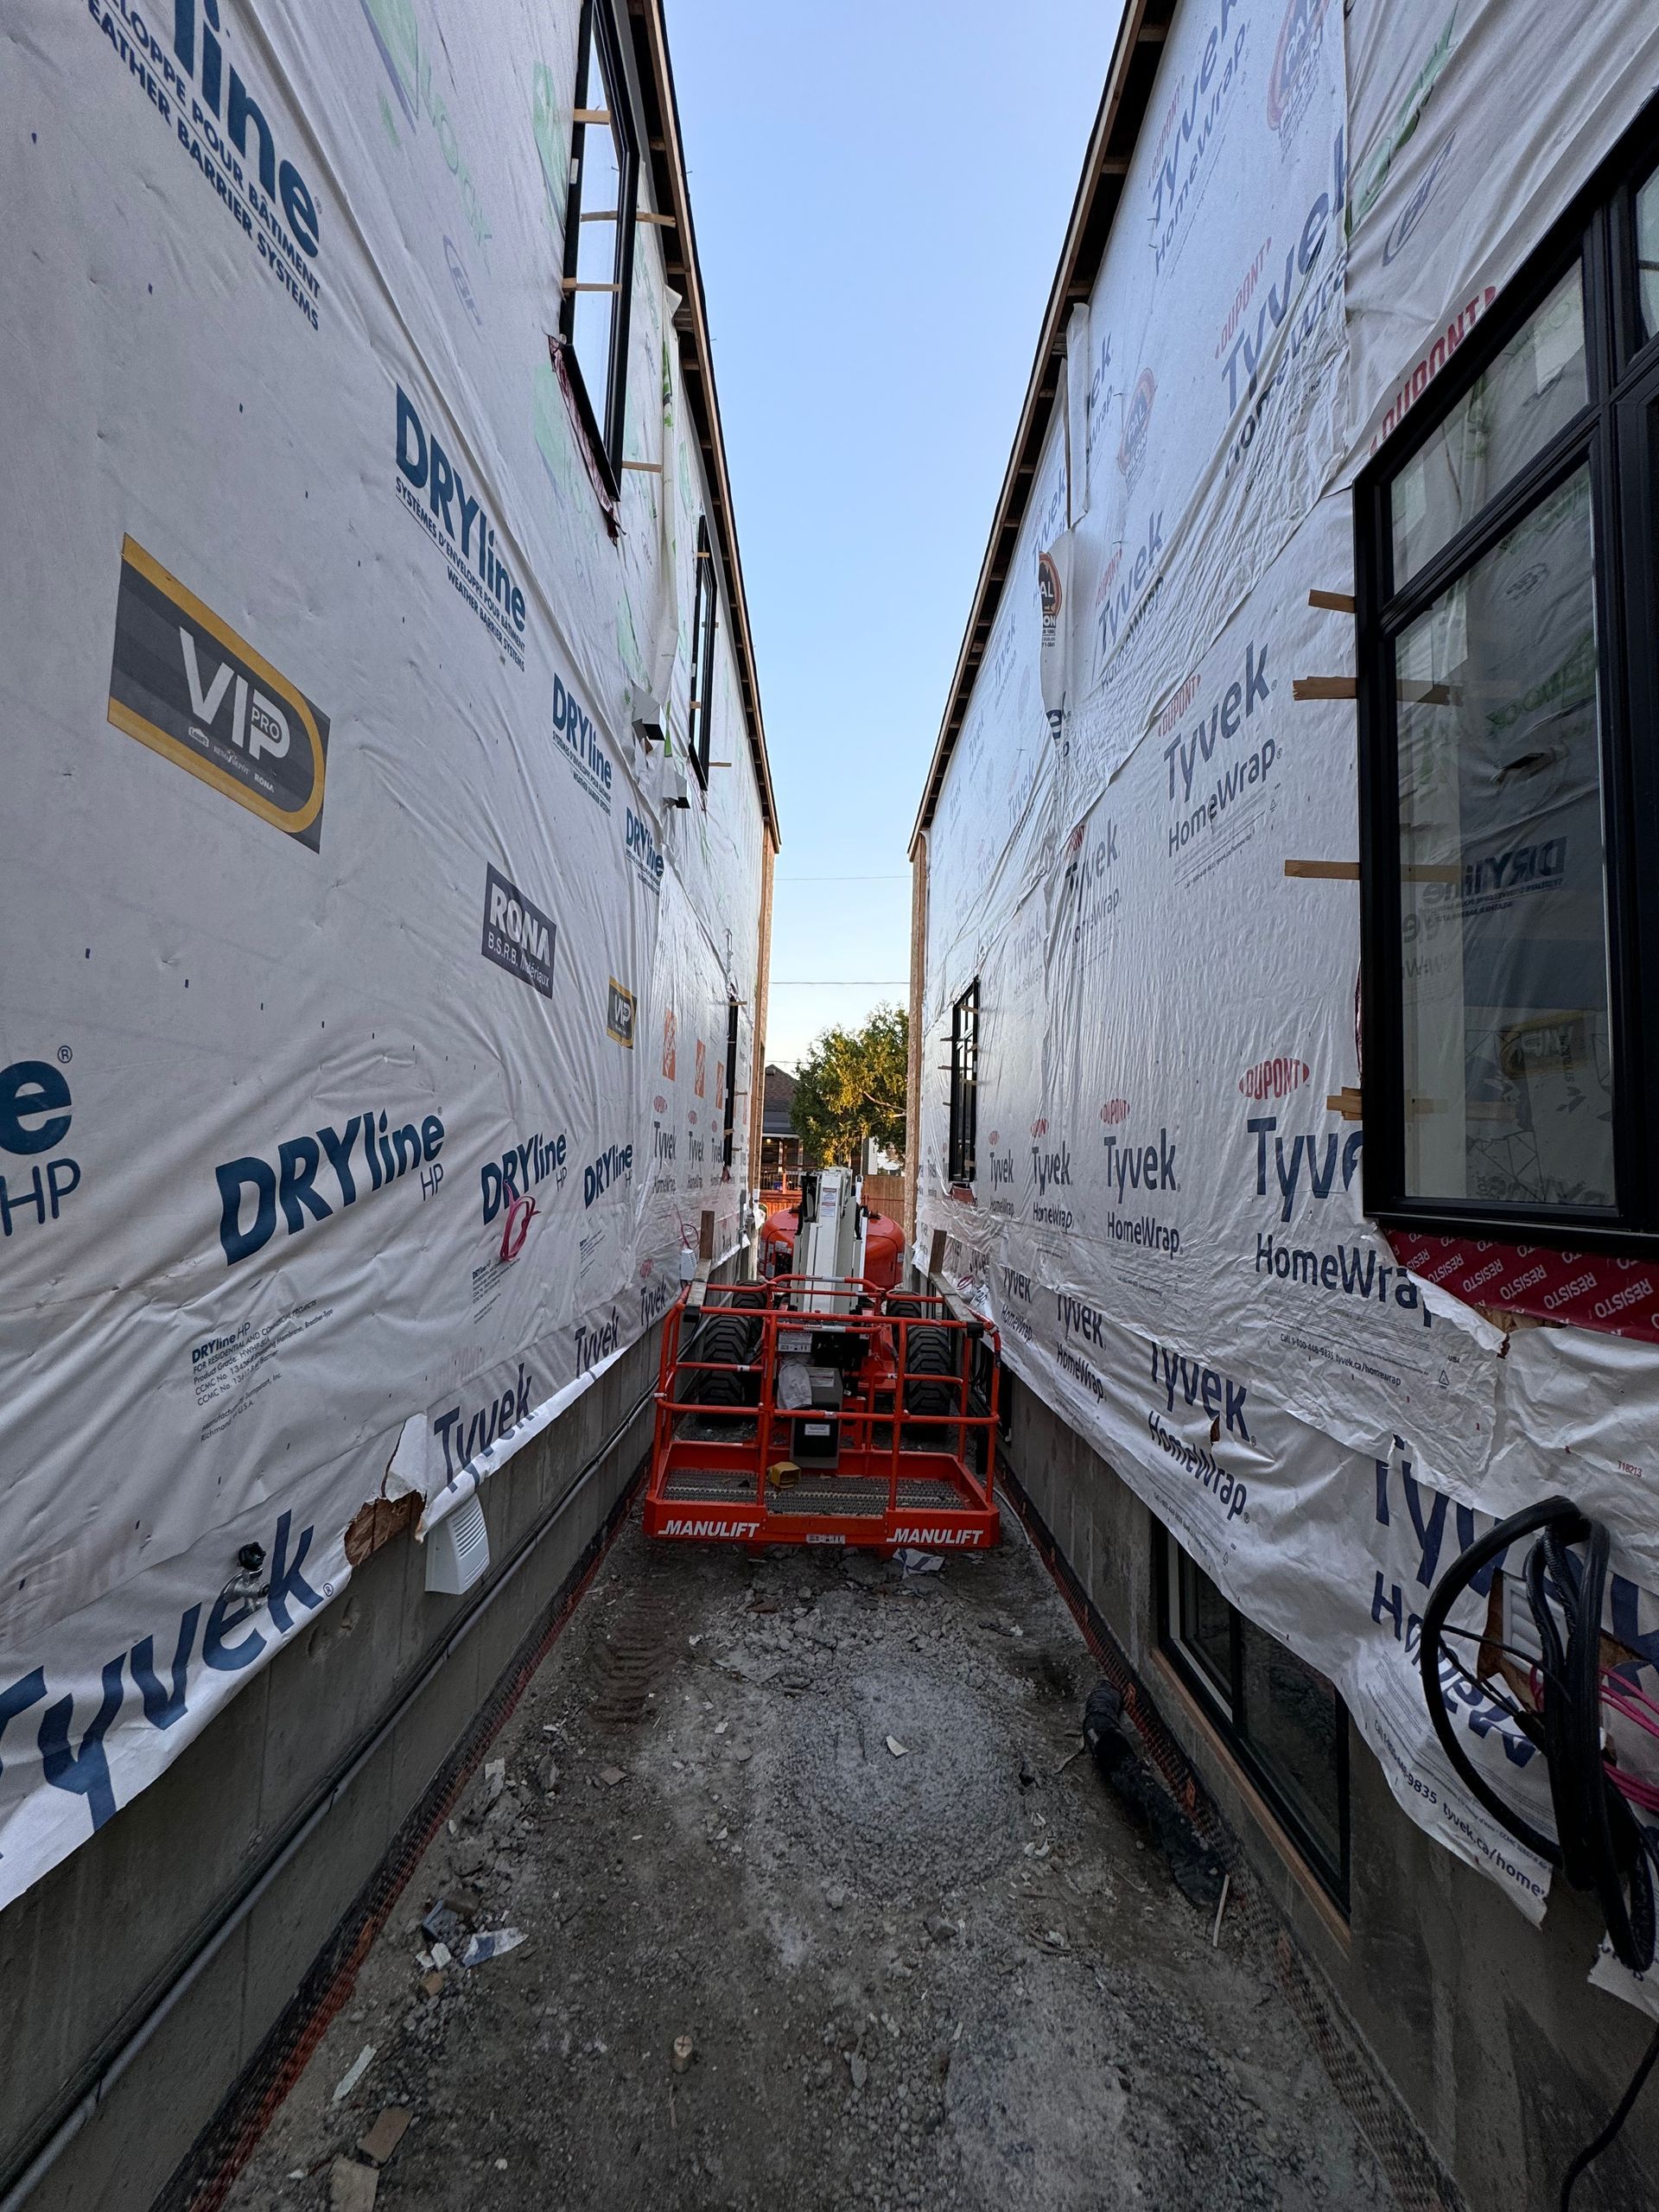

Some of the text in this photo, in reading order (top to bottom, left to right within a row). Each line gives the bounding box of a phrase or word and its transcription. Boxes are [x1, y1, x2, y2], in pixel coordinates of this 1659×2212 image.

[178, 117, 253, 240] BARRIER
[257, 232, 319, 331] SYSTEMS
[192, 99, 243, 189] POUR
[249, 188, 321, 298] BÂTIMENT
[1219, 245, 1265, 354] DUPONT
[396, 381, 526, 632] DRYline
[484, 592, 500, 620] POUR
[1098, 511, 1163, 655] Tyvek
[447, 564, 525, 673] WEATHER BARRIER SYSTEMS
[179, 626, 290, 760] VIP
[251, 705, 281, 741] PRO
[553, 672, 613, 790] DRYline
[1164, 640, 1270, 802] Tyvek
[1169, 739, 1275, 857] HomeWrap
[626, 806, 664, 877] DRYline
[487, 931, 518, 967] B.S.R.B.
[489, 882, 550, 967] RONA
[614, 994, 631, 1026] VIP
[1245, 1058, 1300, 1100] DUPONT
[215, 1108, 444, 1266] DRYline
[420, 1163, 443, 1201] HP
[481, 1132, 567, 1225] DRYline
[556, 1166, 568, 1192] HP
[584, 1142, 632, 1210] DRYline
[989, 1148, 1014, 1191] Tyvek
[1032, 1141, 1071, 1196] Tyvek
[1104, 1128, 1177, 1204] Tyvek
[0, 1158, 81, 1236] HP
[1033, 1202, 1073, 1236] HomeWrap
[1107, 1211, 1179, 1259] HomeWrap
[1462, 1258, 1504, 1293] RESISTO
[1500, 1264, 1548, 1300] RESISTO
[1543, 1272, 1598, 1310] RESISTO
[1594, 1278, 1654, 1319] RESISTO
[640, 1276, 667, 1329] Tyvek
[1001, 1304, 1033, 1344] HomeWrap
[1056, 1294, 1105, 1348] Tyvek
[192, 1322, 251, 1364] DRYline HP
[194, 1363, 207, 1375] FOR
[247, 1332, 261, 1347] AND
[194, 1366, 217, 1385] Product
[195, 1378, 216, 1395] CCMC
[197, 1388, 219, 1407] CCMC
[1056, 1340, 1105, 1403] HomeWrap
[1151, 1341, 1250, 1442] Tyvek
[434, 1363, 535, 1494] Tyvek
[1147, 1410, 1247, 1521] HomeWrap
[658, 1520, 760, 1538] MANULIFT
[886, 1527, 984, 1545] MANULIFT
